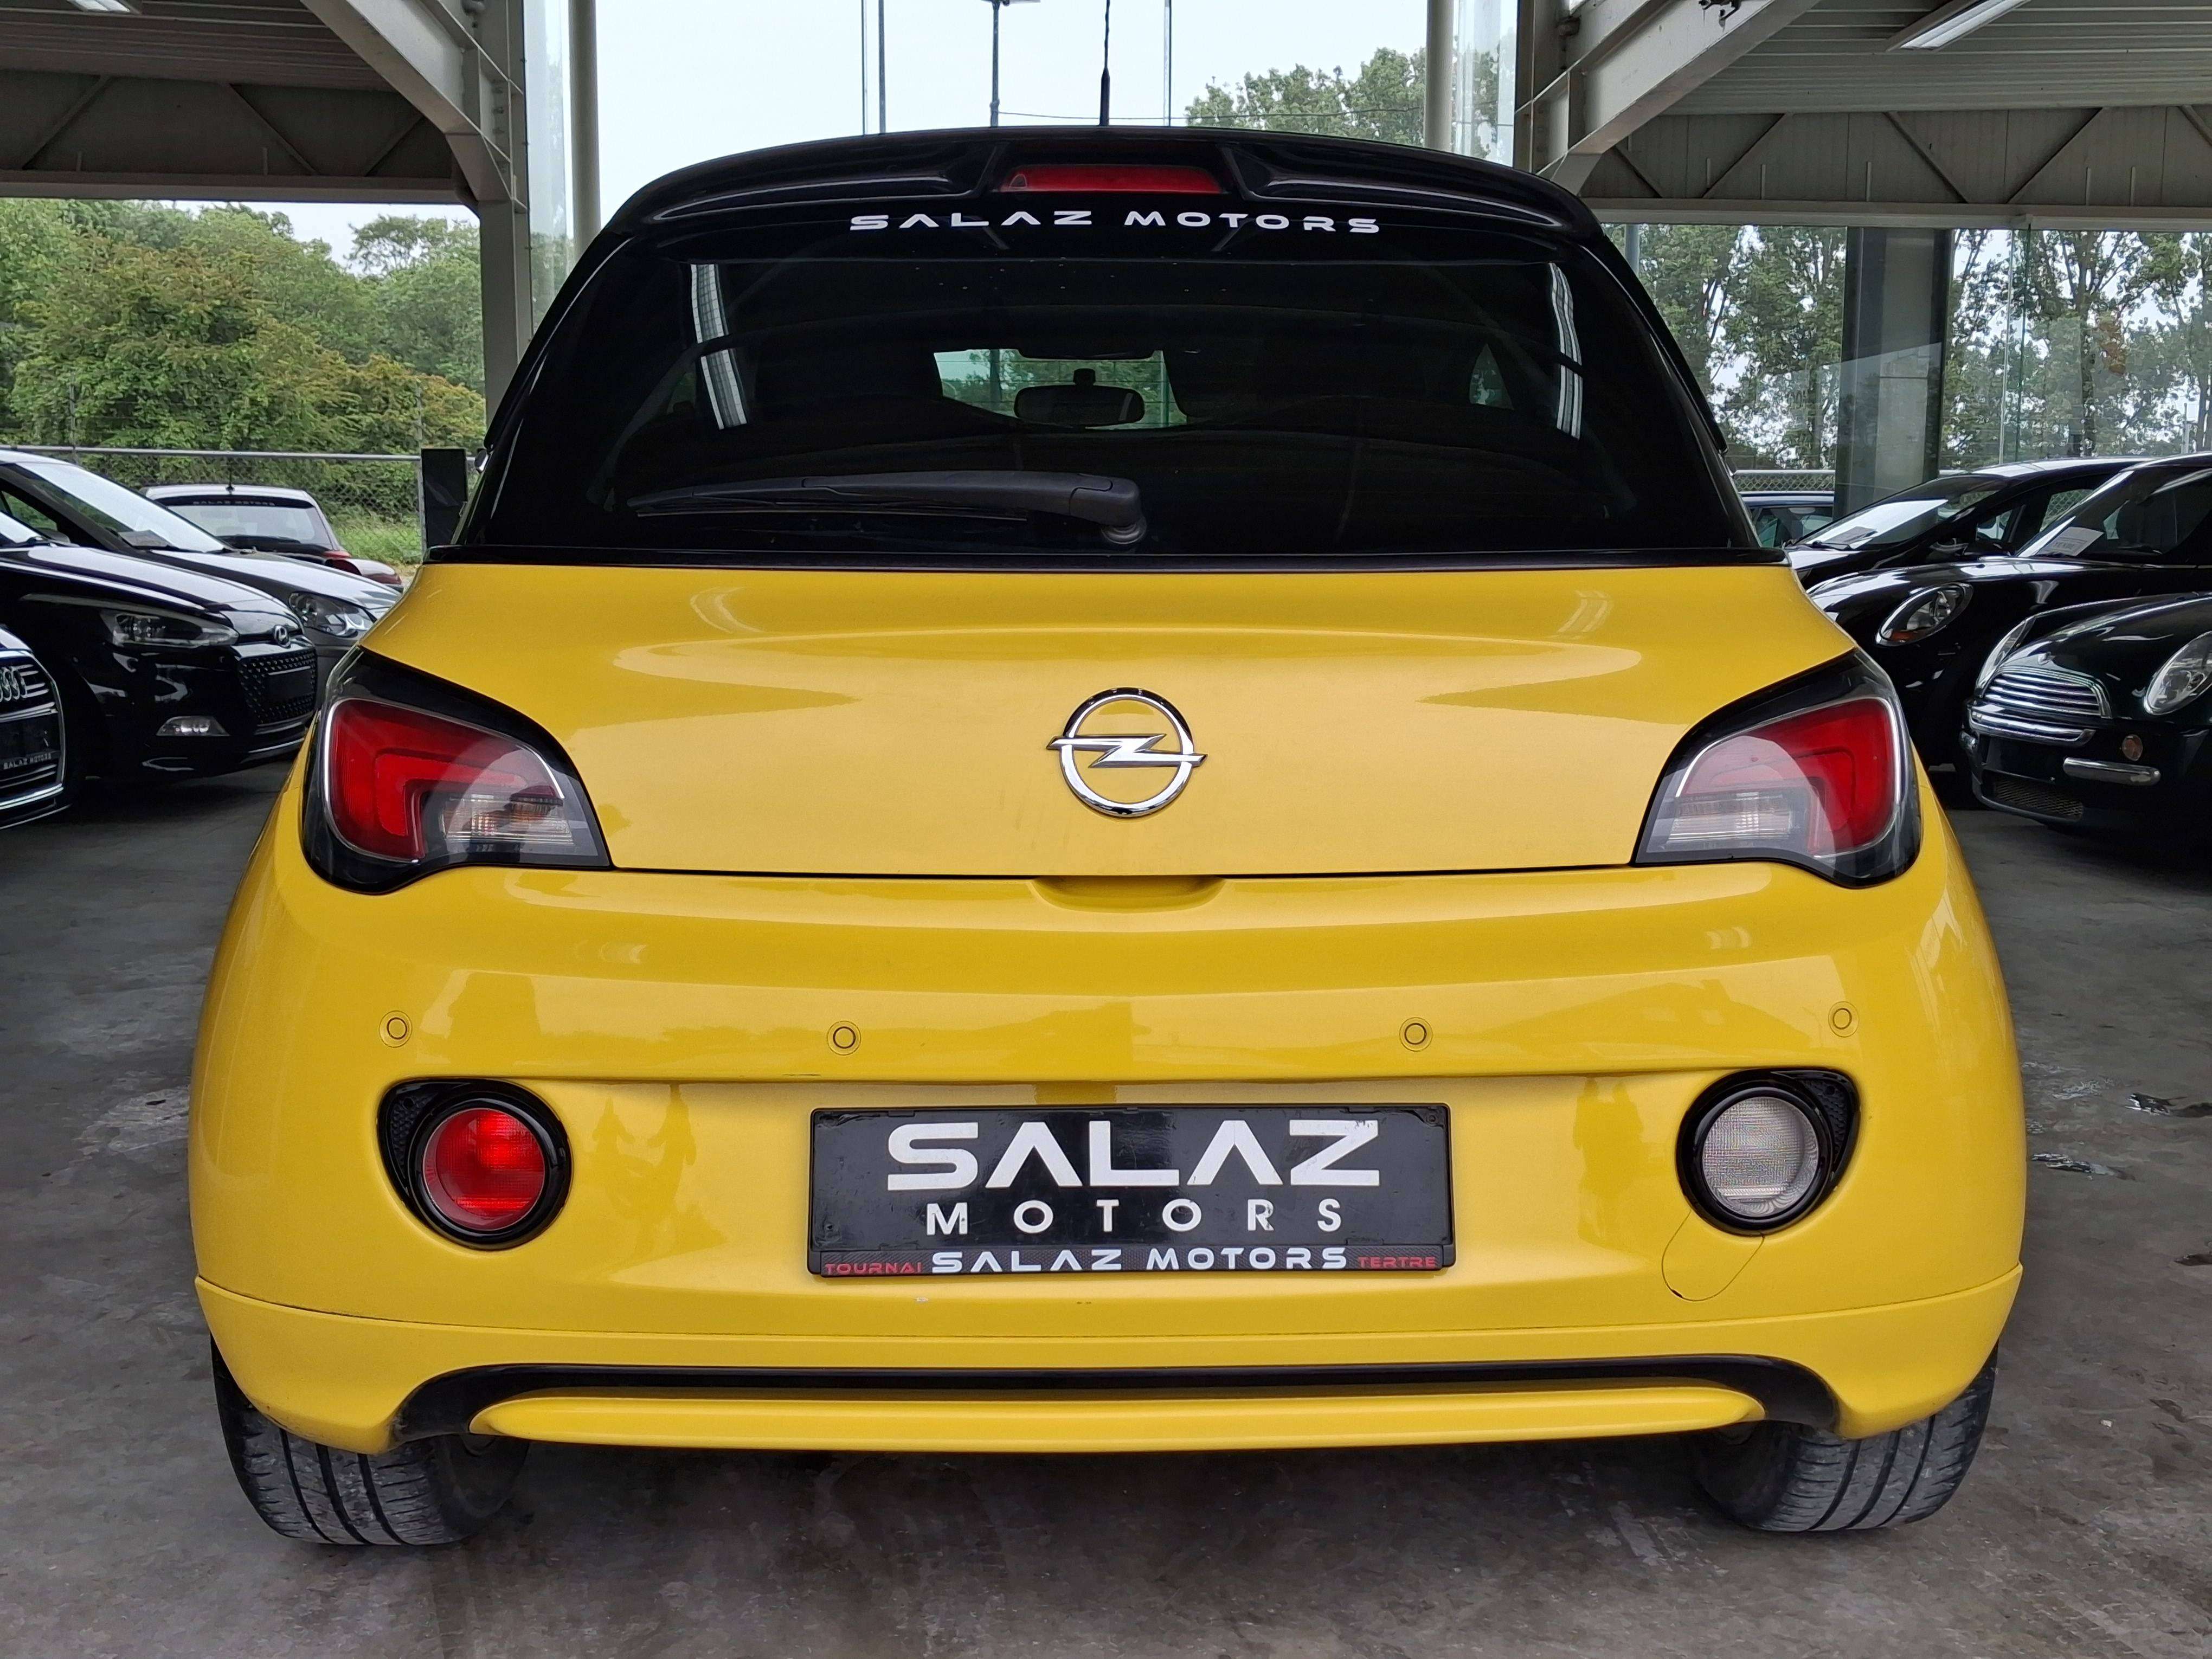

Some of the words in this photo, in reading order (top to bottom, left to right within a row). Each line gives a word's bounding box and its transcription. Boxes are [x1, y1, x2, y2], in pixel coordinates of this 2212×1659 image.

[850, 211, 1092, 231] SALAZ
[1124, 211, 1380, 234] MOTORS
[887, 1119, 1380, 1191] SALAZ
[926, 1198, 1342, 1235] MOTORS
[825, 1262, 923, 1276] TOURNAI
[931, 1249, 1122, 1274] SALAZ
[1146, 1246, 1347, 1270] MOTORS
[1358, 1255, 1437, 1270] TERTRE
